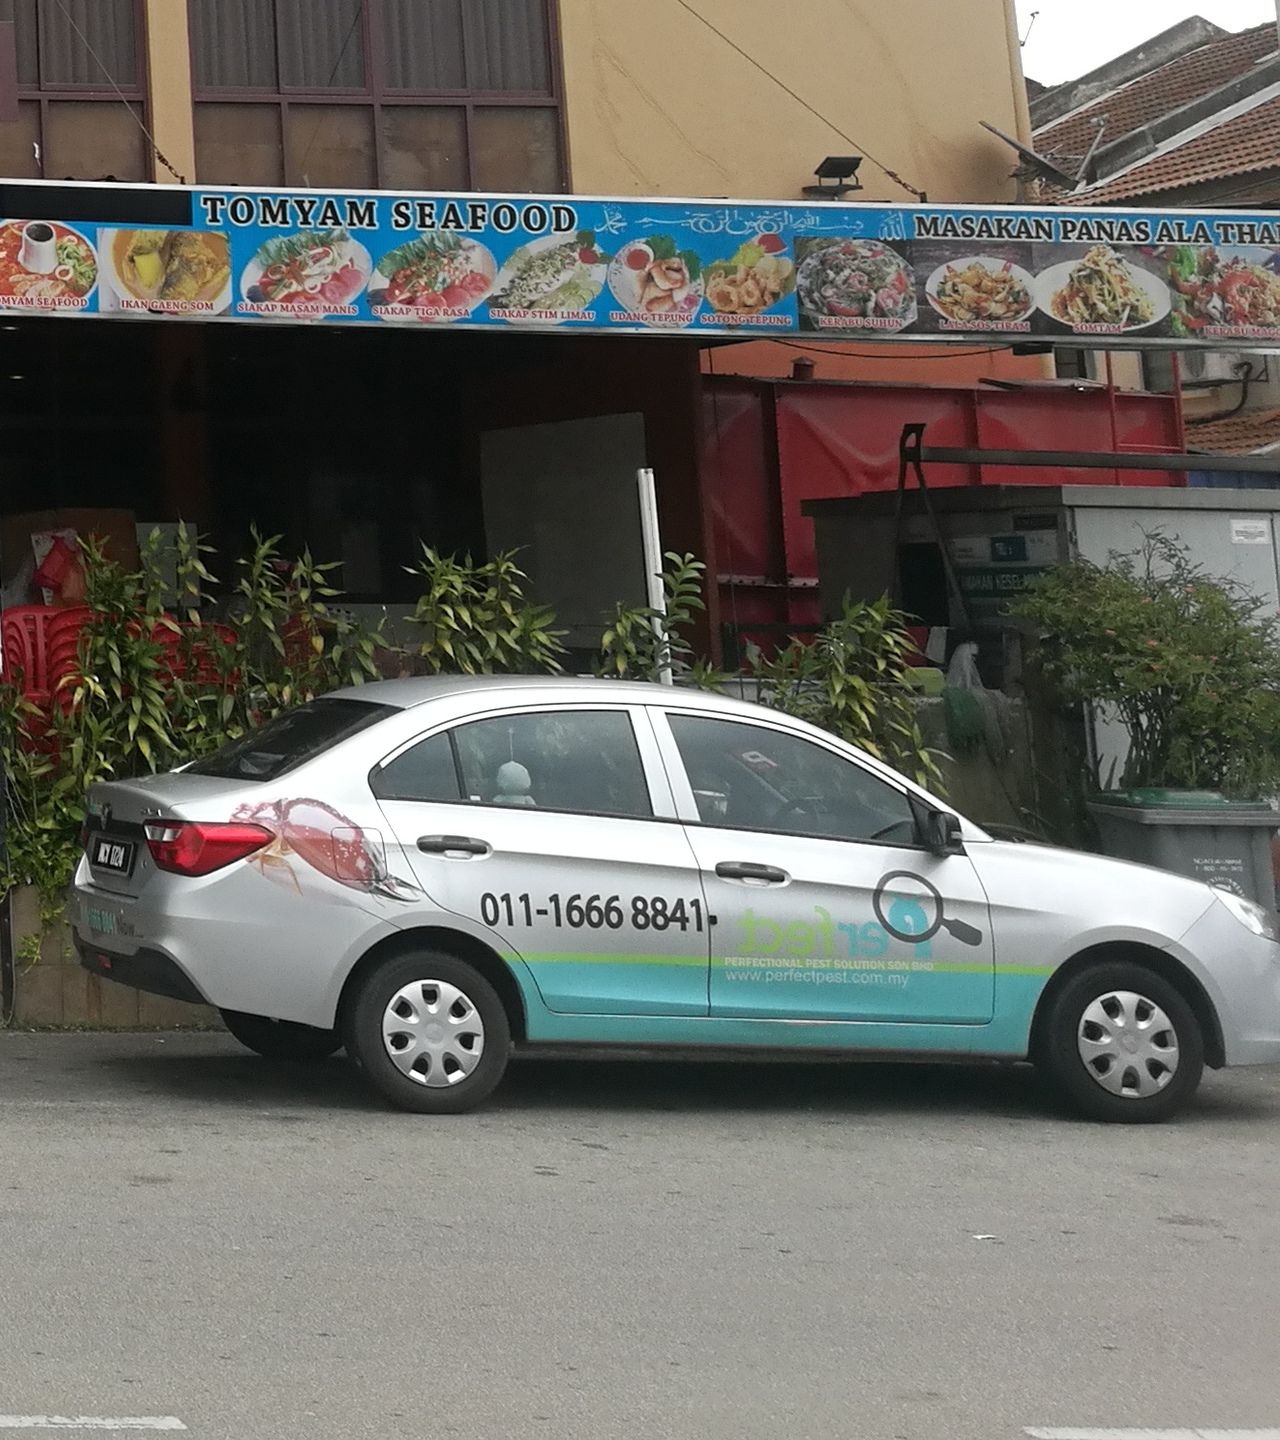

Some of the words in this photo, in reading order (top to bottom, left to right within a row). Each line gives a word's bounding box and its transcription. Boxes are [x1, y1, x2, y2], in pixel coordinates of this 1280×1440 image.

[201, 194, 379, 228] TOMYAM
[392, 200, 578, 233] SEAFOOD
[914, 214, 1054, 242] MASAKAN
[1059, 217, 1150, 243] PANAS
[1156, 220, 1211, 245] ALA
[36, 296, 88, 308] SEAFOOD
[120, 299, 148, 310] IKAN
[150, 300, 189, 312] GAENG
[190, 301, 215, 312] SOM
[237, 301, 278, 313] SIAKAP
[280, 303, 322, 315] MASAM
[322, 304, 358, 316] MANIS
[371, 305, 413, 317] SIAKAP
[414, 306, 442, 317] TIGA
[443, 307, 471, 318] RASA
[489, 308, 530, 320] SIAKAP
[531, 309, 559, 321] STIM
[560, 310, 595, 321] LIMAU
[610, 311, 649, 323] UDANG
[650, 312, 694, 324] TEPUNG
[700, 314, 745, 325] SOTONG
[746, 315, 792, 326] TEPUNG
[818, 316, 862, 328] KERABU
[864, 317, 904, 329] SUHUN
[480, 891, 625, 930] 011-1666
[630, 896, 704, 932] 8841
[724, 956, 803, 969] PERFECTIONAL
[805, 958, 832, 970] PEST
[833, 959, 887, 971] SOLUTION
[887, 960, 910, 972] SDN
[911, 961, 934, 973] BHD
[725, 968, 910, 989] www.perfectpest.com.my
